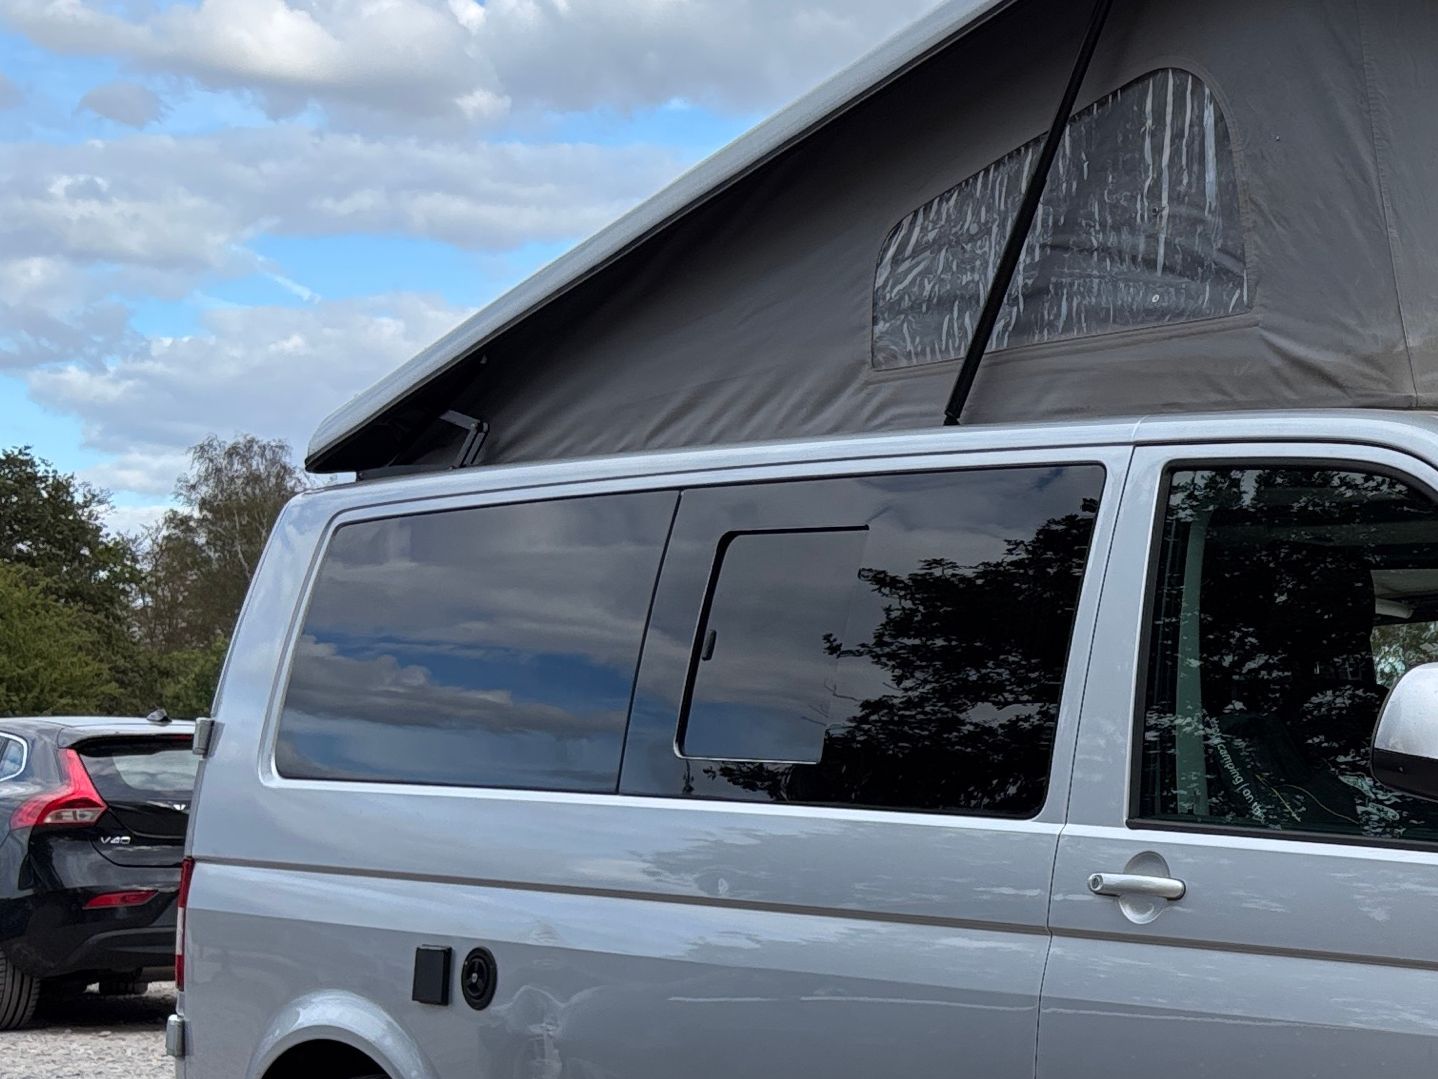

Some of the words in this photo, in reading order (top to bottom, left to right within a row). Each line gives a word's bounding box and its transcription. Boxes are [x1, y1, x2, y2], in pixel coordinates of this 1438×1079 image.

[1217, 743, 1244, 786] camping
[1242, 788, 1255, 804] on
[100, 836, 131, 845] V40
